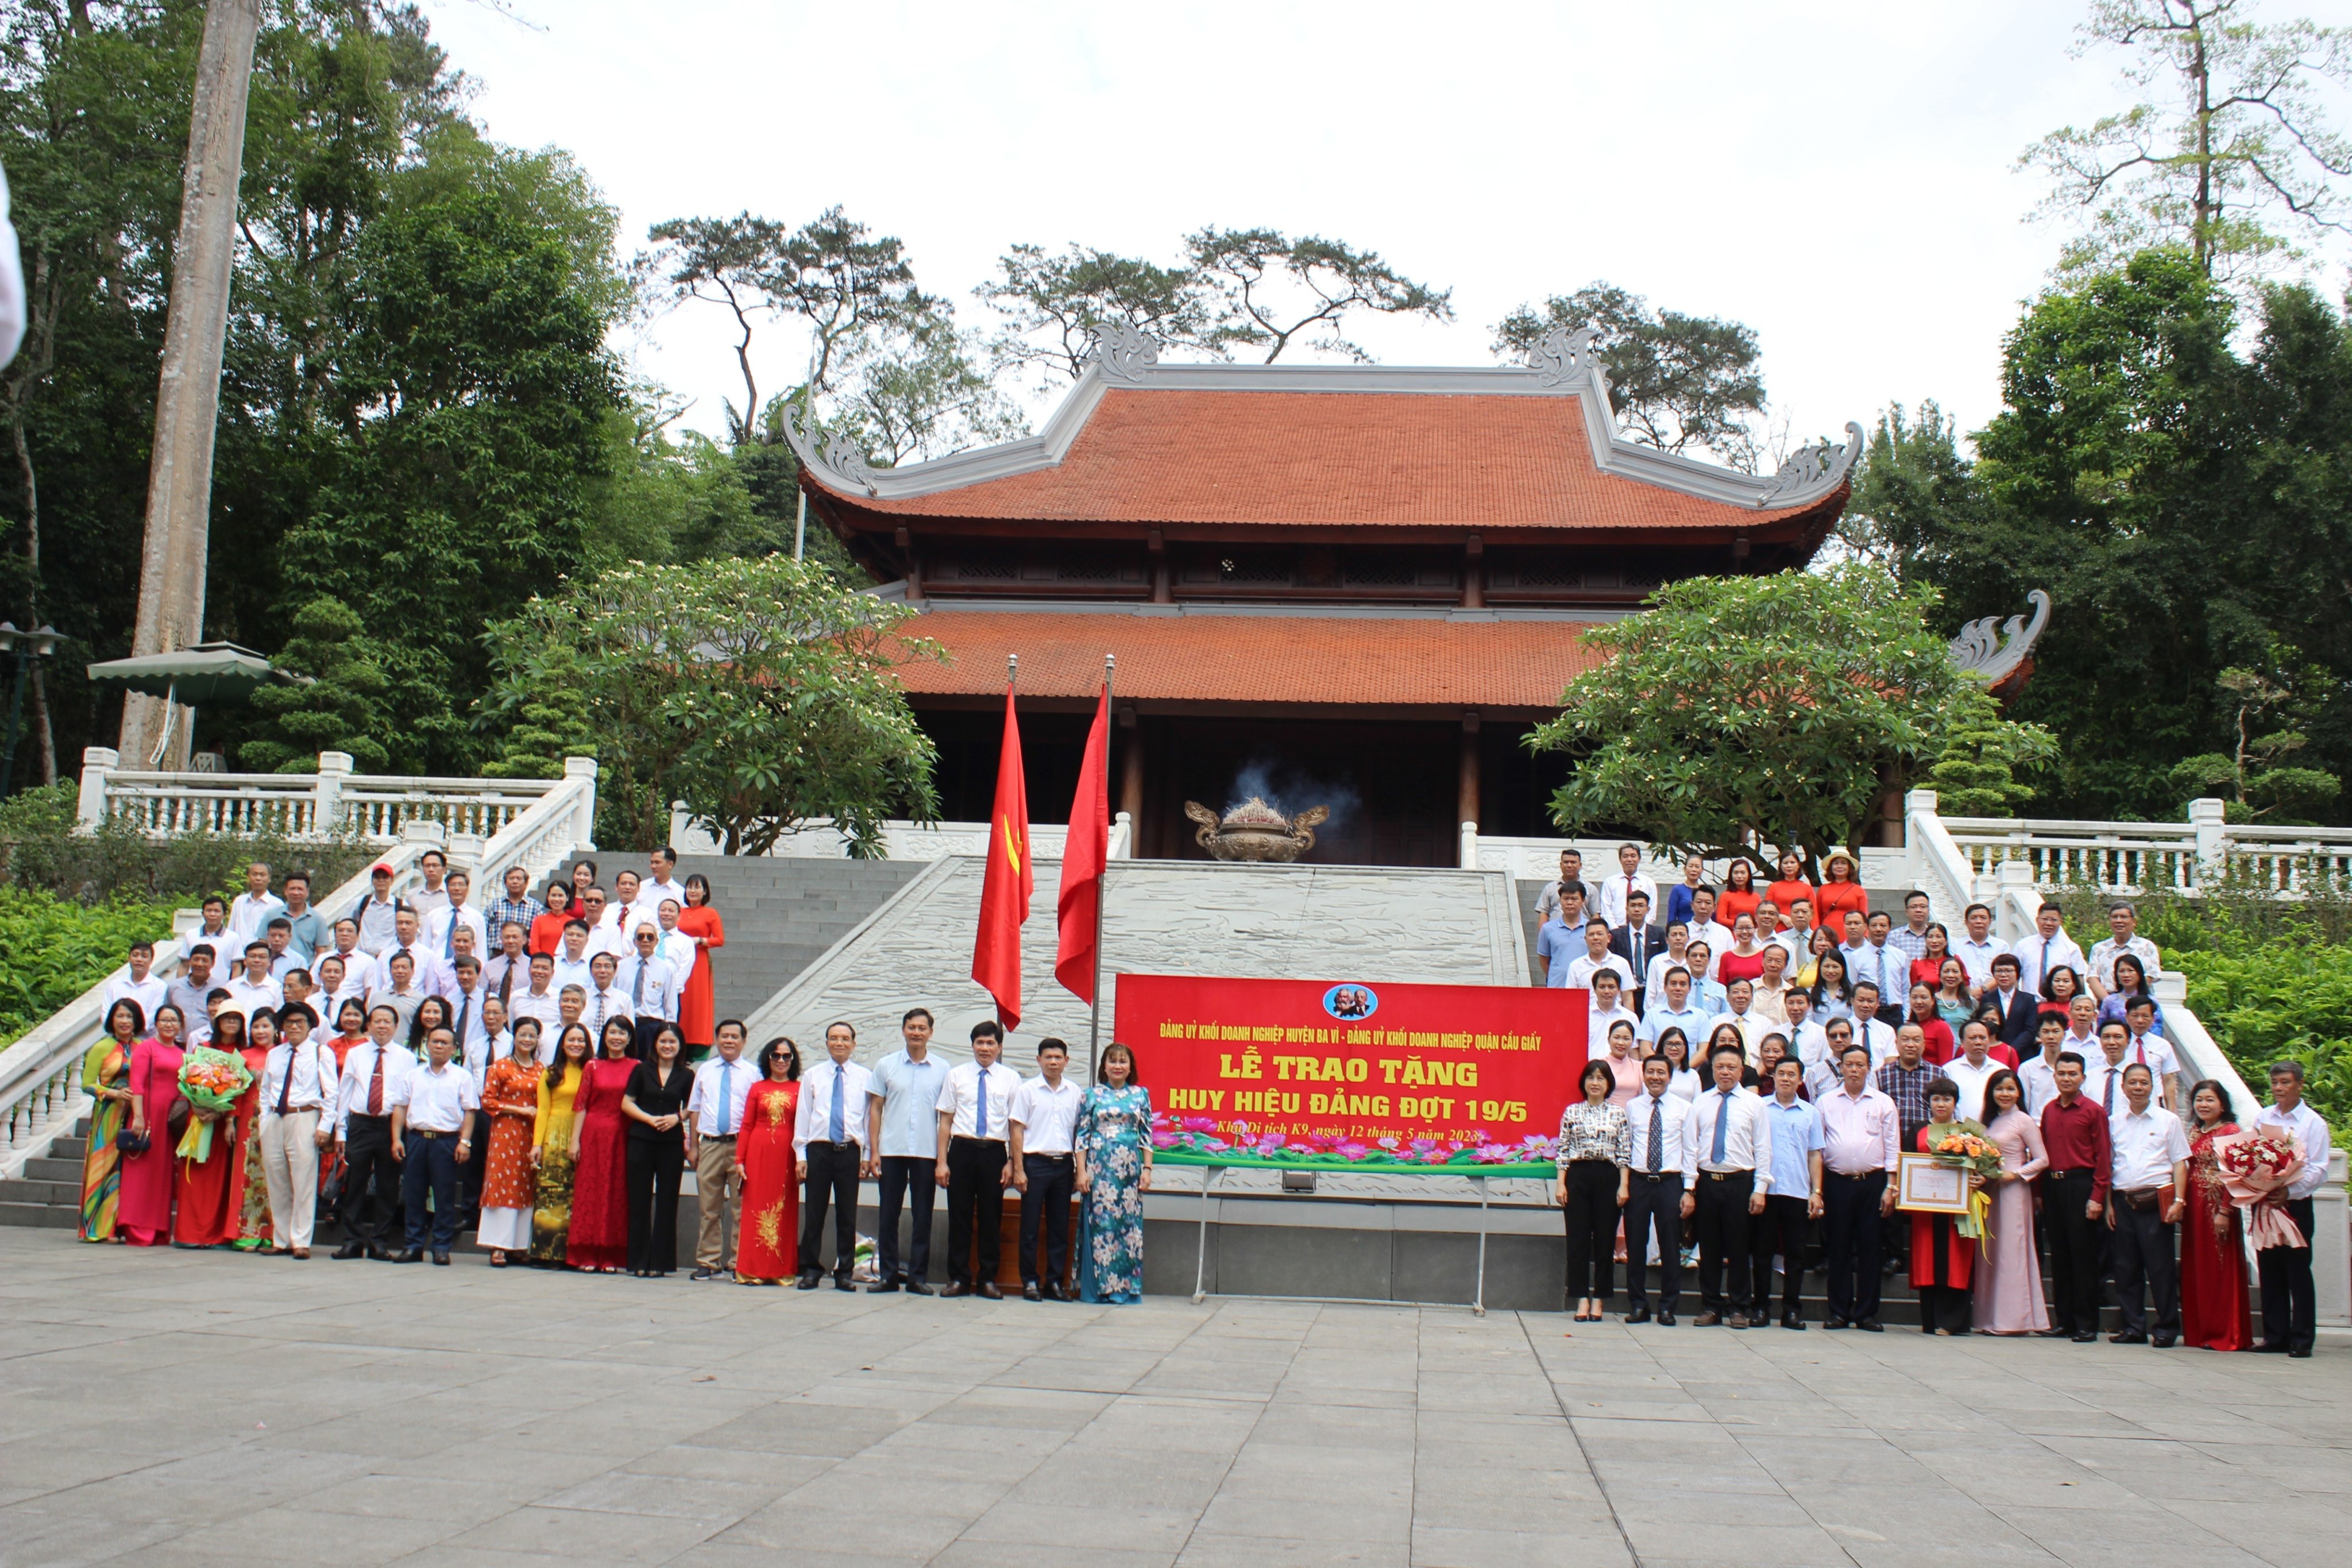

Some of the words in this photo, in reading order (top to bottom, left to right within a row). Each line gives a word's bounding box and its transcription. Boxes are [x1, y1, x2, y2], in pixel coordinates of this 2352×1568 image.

[1160, 1018, 1184, 1038] ĐẢNG
[1199, 1020, 1219, 1040] KHỐI
[1221, 1025, 1250, 1041] DOANH
[1252, 1024, 1284, 1045] NGHIỆP
[1286, 1025, 1315, 1046] HUYỆN
[1316, 1028, 1328, 1044] BA
[1330, 1026, 1339, 1044] VÌ
[1347, 1025, 1371, 1044] ĐẢNG
[1387, 1026, 1407, 1046] KHỐI
[1409, 1032, 1439, 1048] DOANH
[1440, 1030, 1473, 1052] NGHIỆP
[1475, 1032, 1499, 1053] QUẬN
[1501, 1030, 1519, 1051] CẦU
[1521, 1030, 1541, 1051] GIẤY
[1219, 1045, 1262, 1079] LỄ
[1273, 1055, 1368, 1082] TRAO
[1379, 1055, 1478, 1089] TẶNG
[1169, 1088, 1226, 1111] HUY
[1234, 1087, 1300, 1118] HIỆU
[1309, 1087, 1390, 1117] ĐẢNG
[1399, 1096, 1455, 1123] ĐỢT
[1465, 1100, 1527, 1122] 19/5
[1216, 1121, 1243, 1133] Khu
[1247, 1121, 1262, 1134] Di
[1291, 1123, 1311, 1136] K9,
[1316, 1124, 1346, 1140] ngày
[1350, 1125, 1364, 1137] 12
[1367, 1126, 1403, 1142] tháng
[1406, 1127, 1414, 1140] 5
[1418, 1128, 1445, 1141] năm
[1448, 1129, 1478, 1142] 2023
